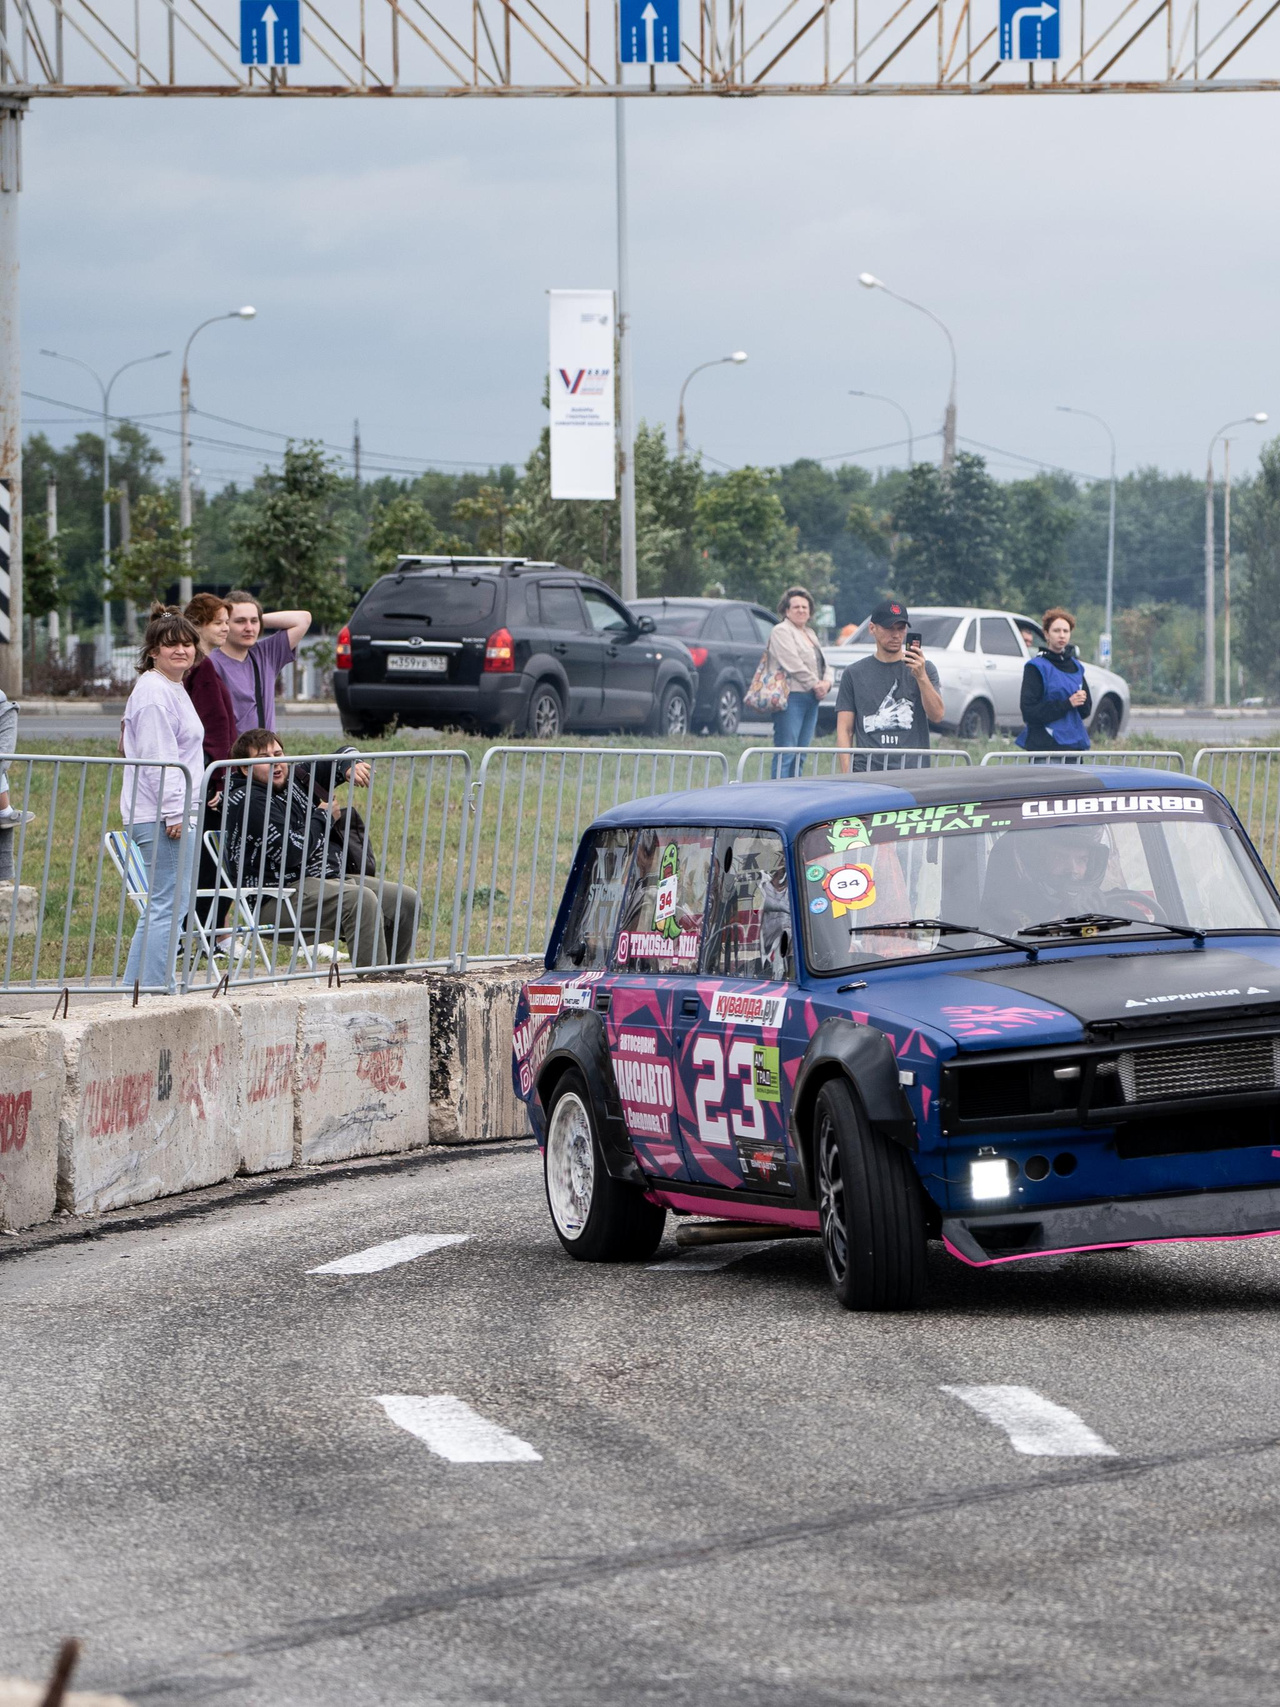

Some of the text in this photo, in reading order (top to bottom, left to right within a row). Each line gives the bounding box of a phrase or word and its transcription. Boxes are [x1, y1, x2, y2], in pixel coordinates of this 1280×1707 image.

[871, 802, 982, 828] DRIFT
[1021, 796, 1204, 818] CLUBTURBO
[837, 879, 860, 889] 34
[659, 891, 672, 910] 34
[1145, 988, 1241, 1003] ЧЕРНИЧКА
[716, 995, 780, 1025] кувалда.ру
[620, 1033, 656, 1055] автосервис
[692, 1037, 766, 1146] 23
